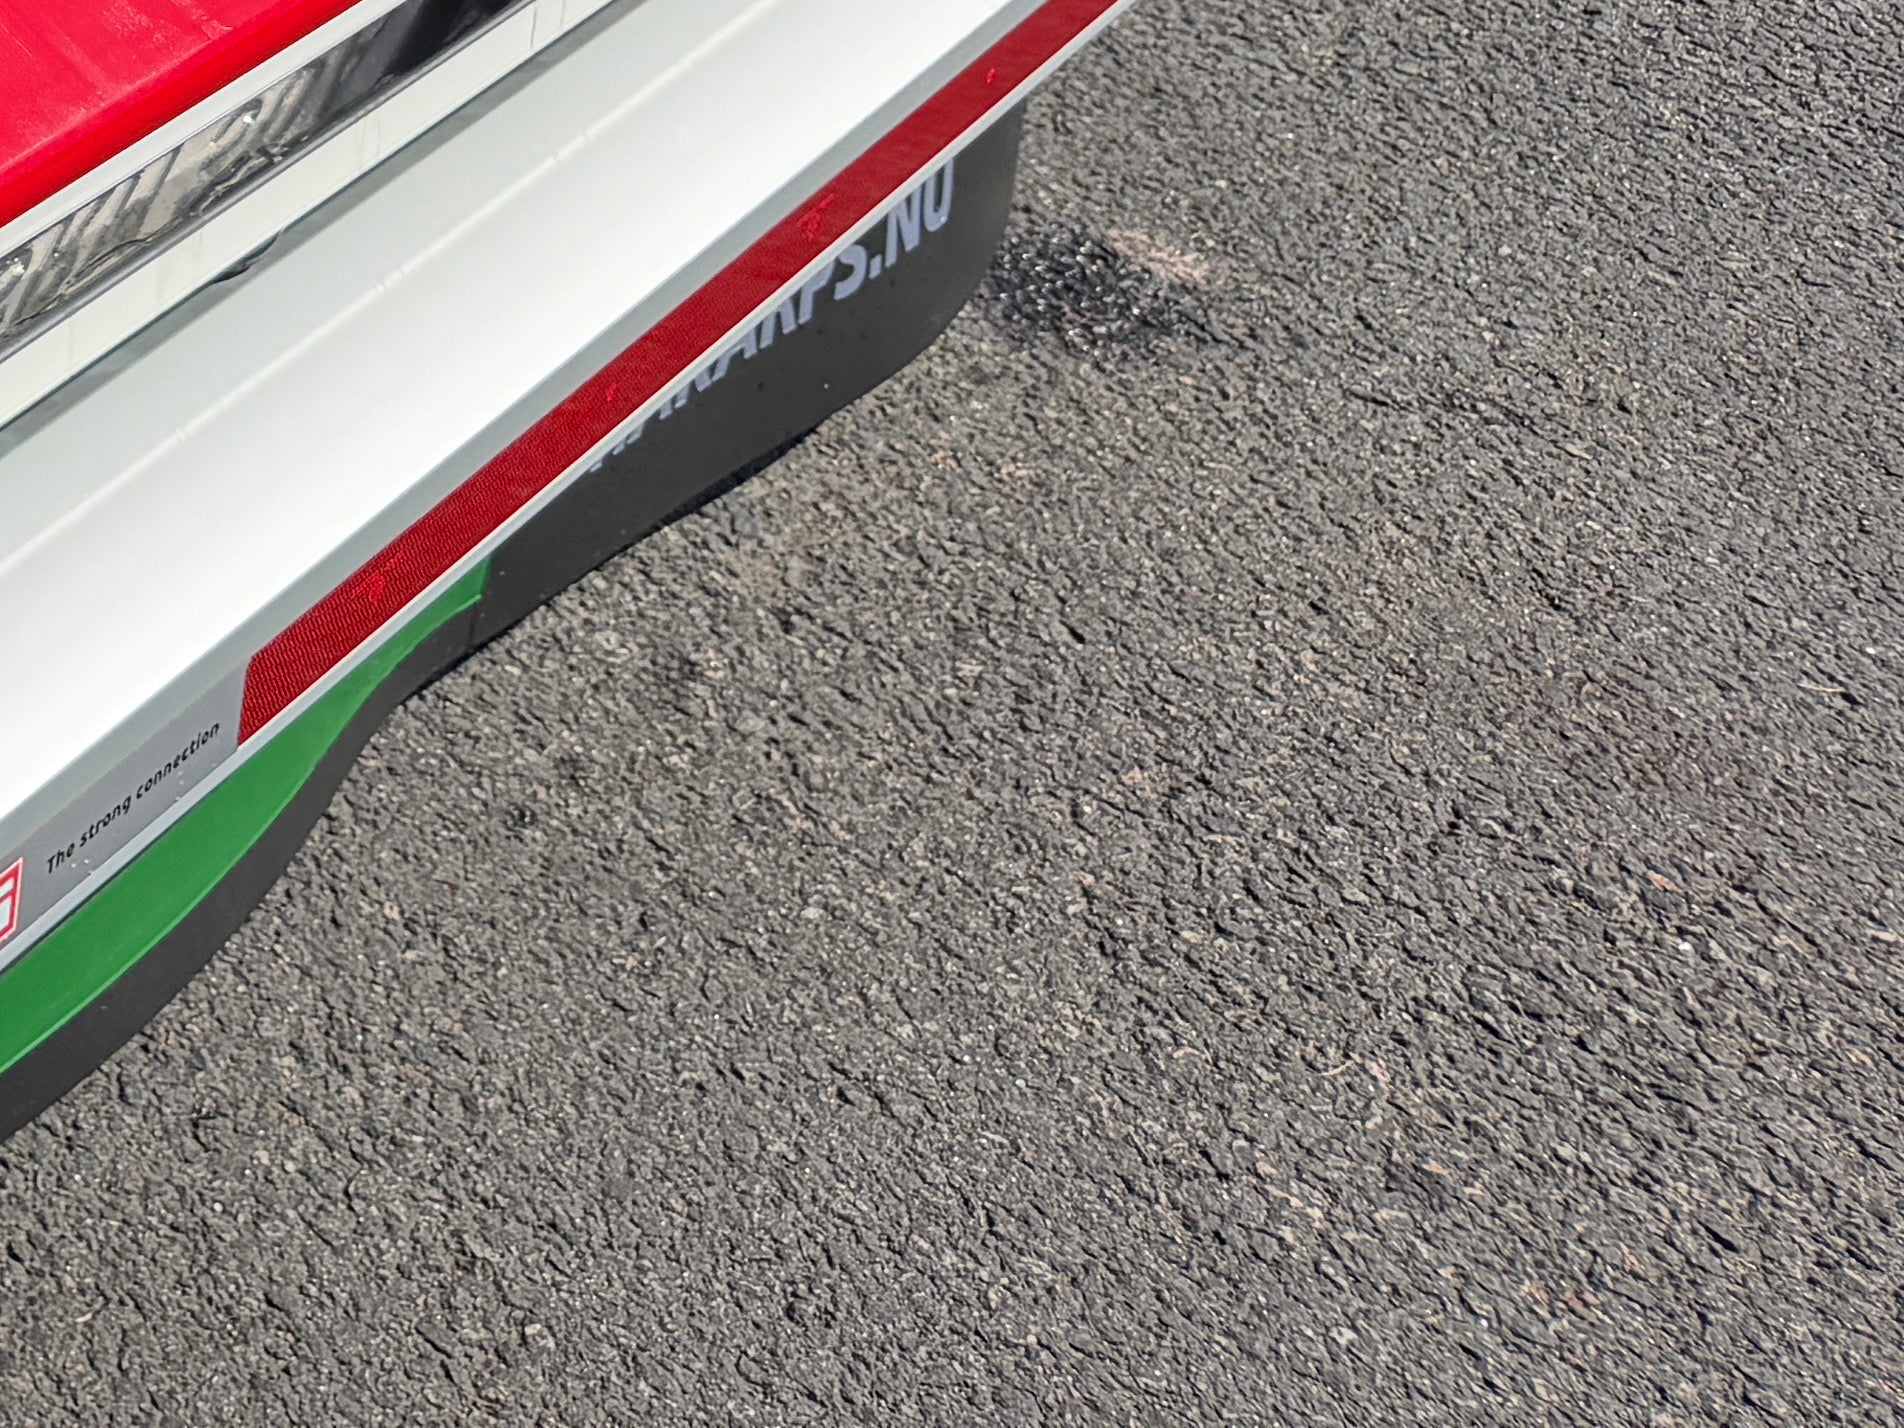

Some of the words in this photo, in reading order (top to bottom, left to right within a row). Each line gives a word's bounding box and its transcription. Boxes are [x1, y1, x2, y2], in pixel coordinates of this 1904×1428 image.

[47, 842, 74, 874] The
[79, 795, 132, 847] strong
[136, 723, 219, 799] connection
